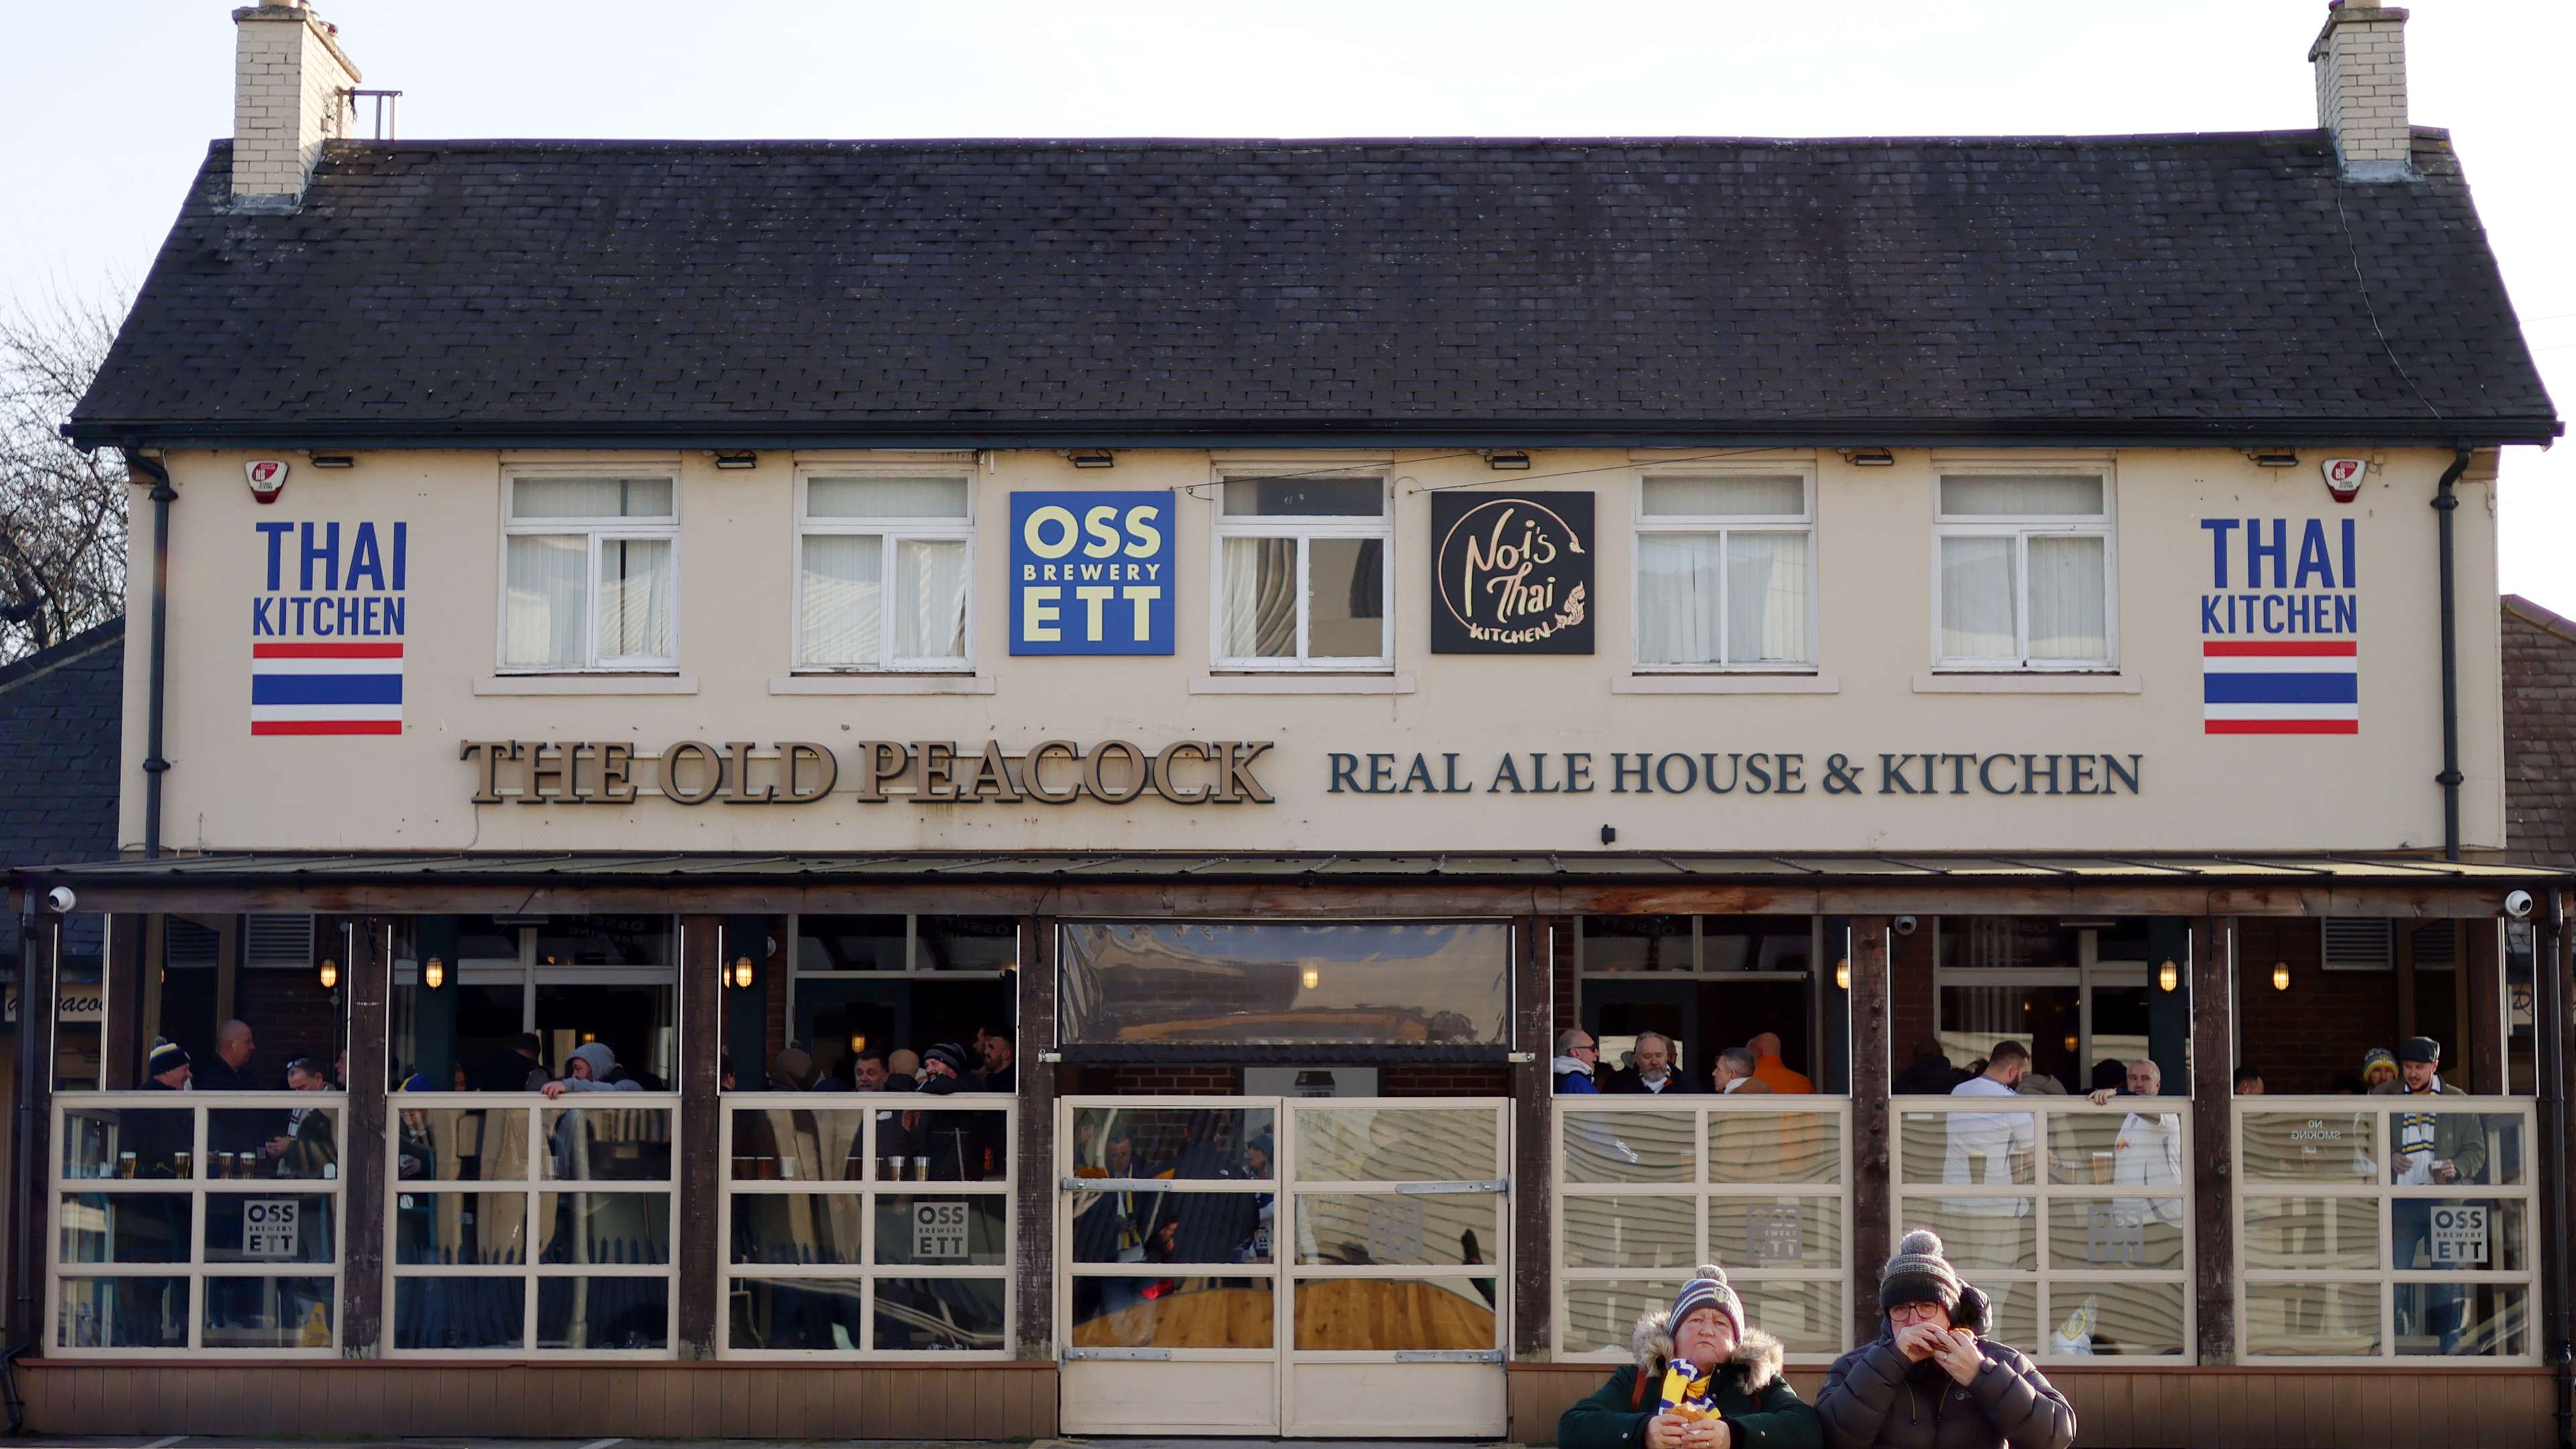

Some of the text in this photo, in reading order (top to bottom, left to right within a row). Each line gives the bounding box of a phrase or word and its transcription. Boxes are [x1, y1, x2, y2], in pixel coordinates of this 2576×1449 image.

[1024, 505, 1161, 559] OSS
[256, 522, 407, 590] THAI
[1024, 564, 1160, 580] BREWERY
[1464, 507, 1556, 617] Noi's
[2200, 519, 2356, 588] THAI
[1487, 561, 1556, 623] Thai
[253, 597, 405, 635] KITCHEN
[1024, 586, 1161, 641] ETT
[1470, 621, 1551, 643] KITCHEN
[2201, 594, 2357, 633] KITCHEN
[460, 739, 1275, 805] THE OLD PEACOCK
[1327, 752, 2143, 794] REAL ALE HOUSE & KITCHEN
[248, 1204, 294, 1223] OSS
[918, 1206, 964, 1225] OSS
[2435, 1210, 2482, 1229] OSS
[250, 1235, 293, 1252] ETT
[920, 1237, 963, 1254] ETT
[2438, 1242, 2482, 1259] ETT
